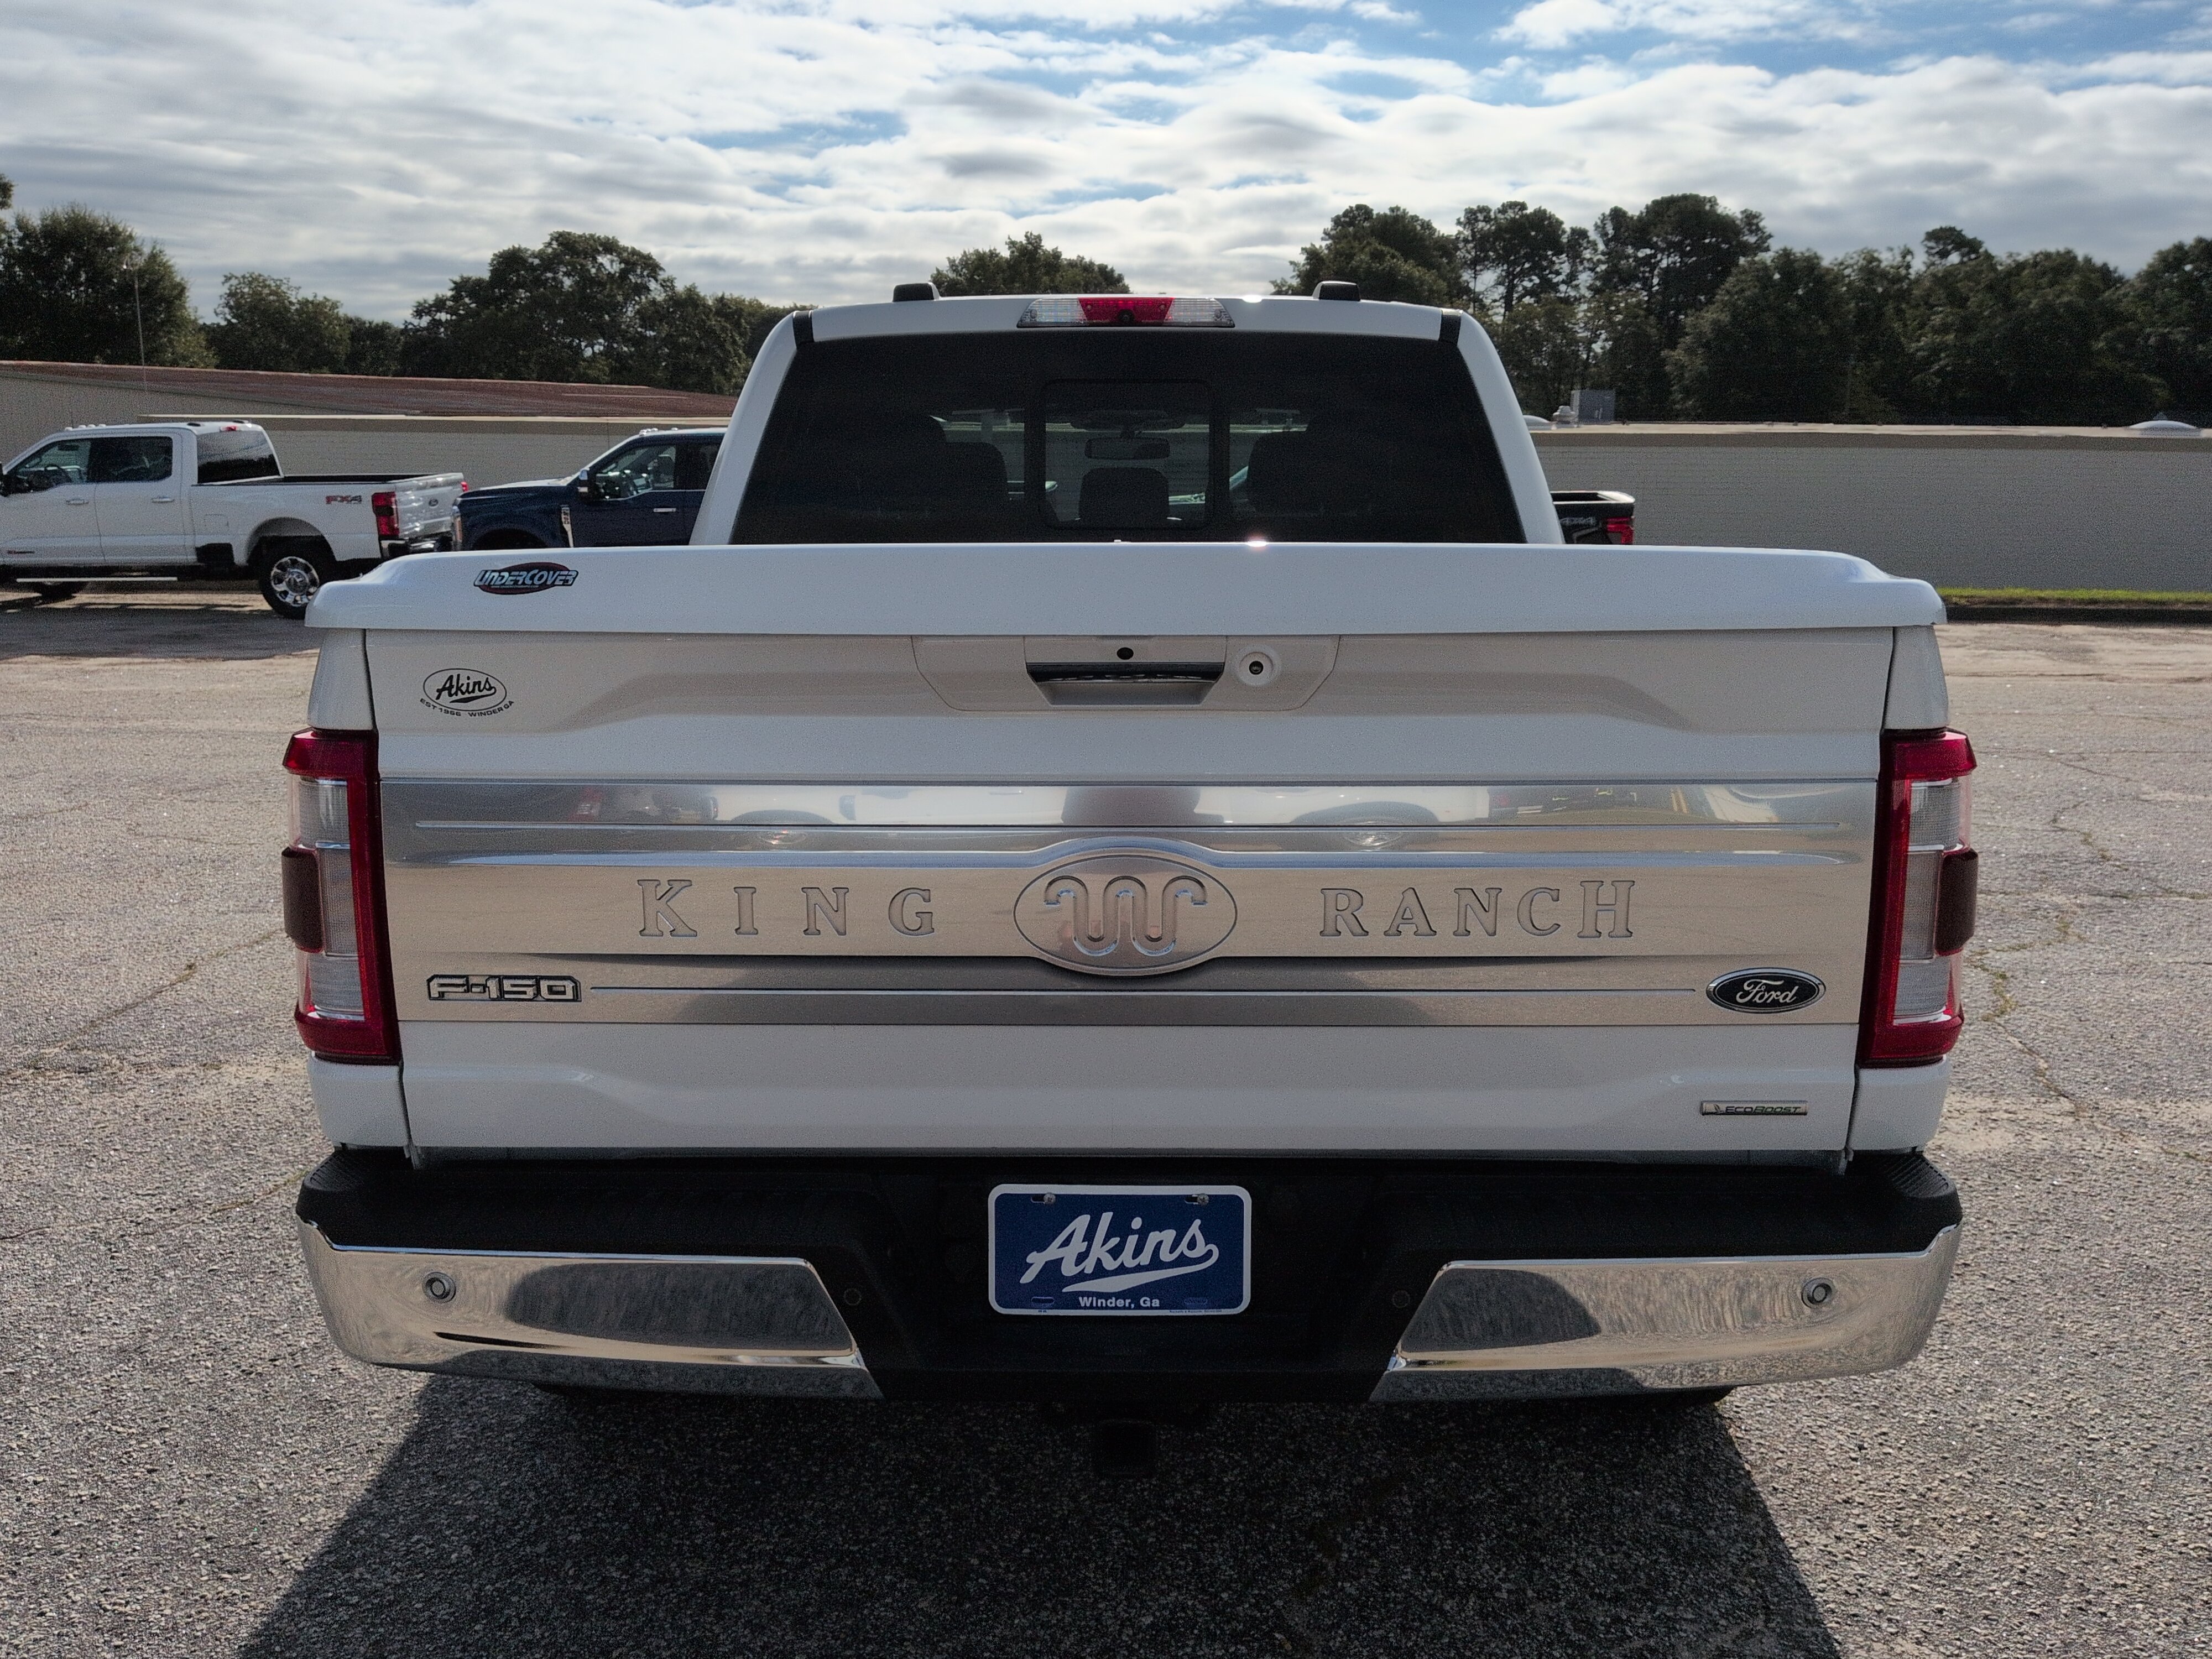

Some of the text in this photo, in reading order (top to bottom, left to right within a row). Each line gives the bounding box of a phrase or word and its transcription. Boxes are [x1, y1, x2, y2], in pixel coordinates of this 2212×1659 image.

[474, 569, 578, 586] UNDERCOVER
[435, 674, 497, 700] Akins
[439, 707, 461, 717] 1966
[468, 707, 504, 717] WINDER
[503, 700, 515, 709] GA
[637, 879, 1635, 939] KING RANCH
[426, 974, 582, 1002] F-150
[1735, 978, 1799, 1004] Ford
[1019, 1212, 1219, 1284] Akins
[1078, 1296, 1161, 1310] Winder, Ga
